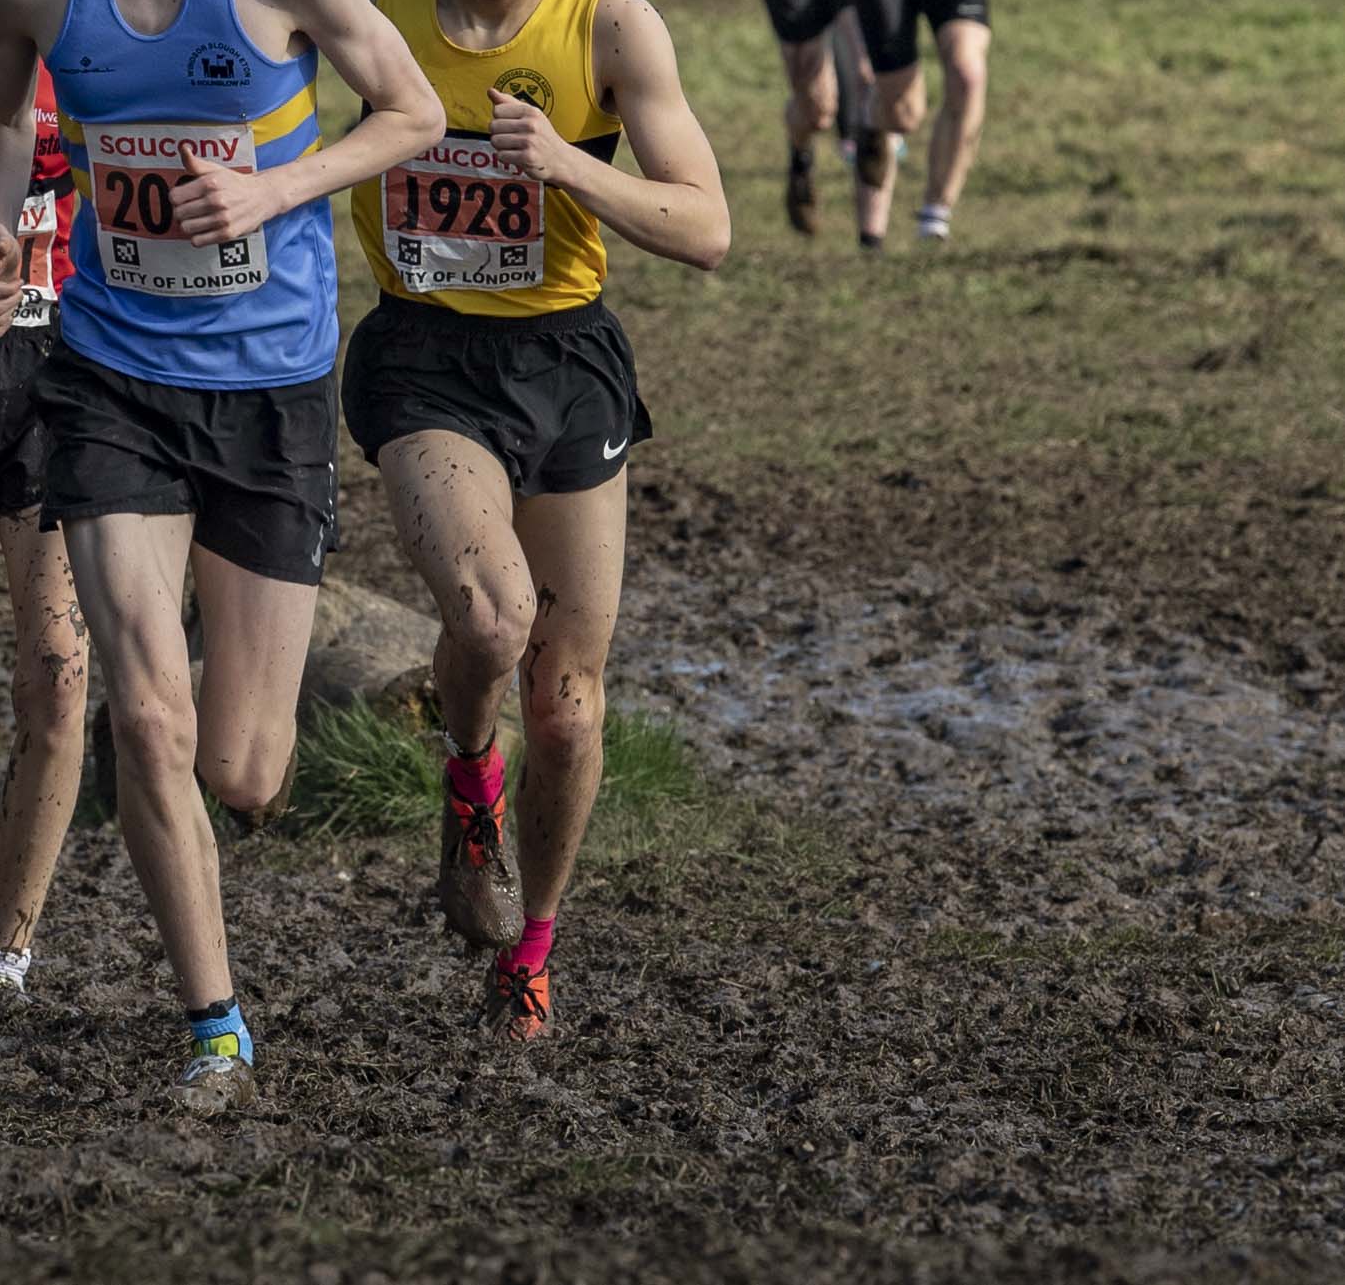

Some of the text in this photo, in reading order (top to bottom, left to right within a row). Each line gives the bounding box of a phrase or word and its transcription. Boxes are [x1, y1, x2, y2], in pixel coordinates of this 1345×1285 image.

[99, 133, 239, 161] saucony
[105, 171, 195, 235] 20
[404, 174, 532, 240] 1928
[111, 269, 148, 285] CITY
[153, 276, 176, 288] OF
[182, 270, 262, 289] LONDON
[399, 269, 537, 284] ITY OF LONDON
